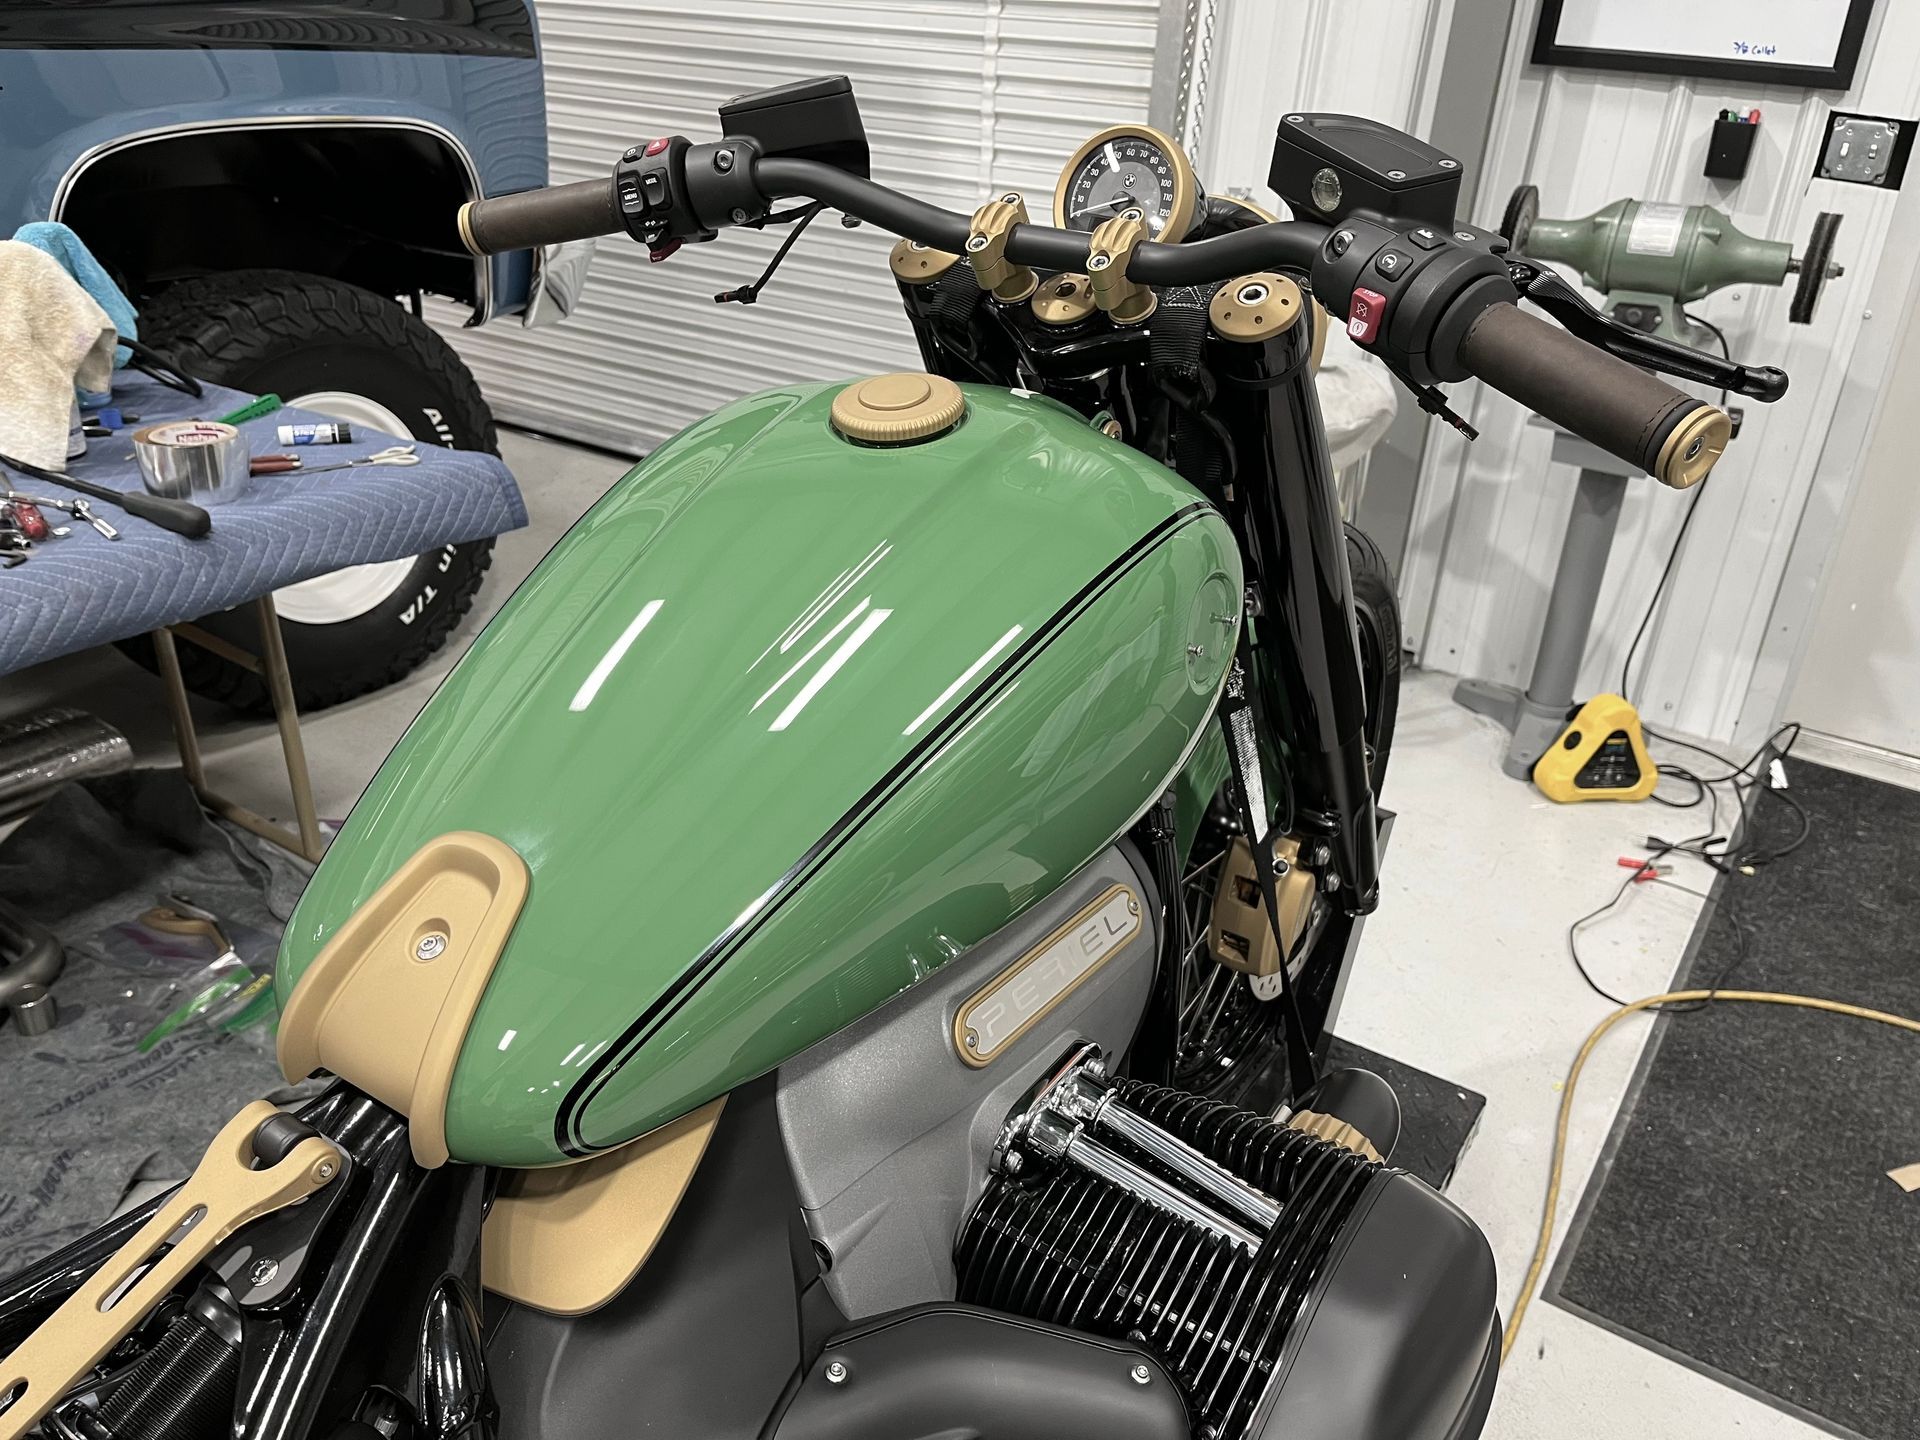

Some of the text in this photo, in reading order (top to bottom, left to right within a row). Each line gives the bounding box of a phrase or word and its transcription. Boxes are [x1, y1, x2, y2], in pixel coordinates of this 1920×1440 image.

[1126, 148, 1136, 156] 60
[1140, 149, 1148, 158] 70
[1100, 158, 1109, 166] 40
[1149, 156, 1159, 164] 80
[1090, 168, 1099, 177] 30
[1157, 166, 1166, 174] 90
[1082, 180, 1091, 189] 20
[1160, 178, 1172, 188] 100
[624, 192, 638, 200] MENU
[1077, 195, 1085, 203] 10
[1162, 193, 1173, 202] 110
[1159, 207, 1171, 217] 120
[1363, 289, 1378, 298] STOP
[398, 584, 439, 626] T/A
